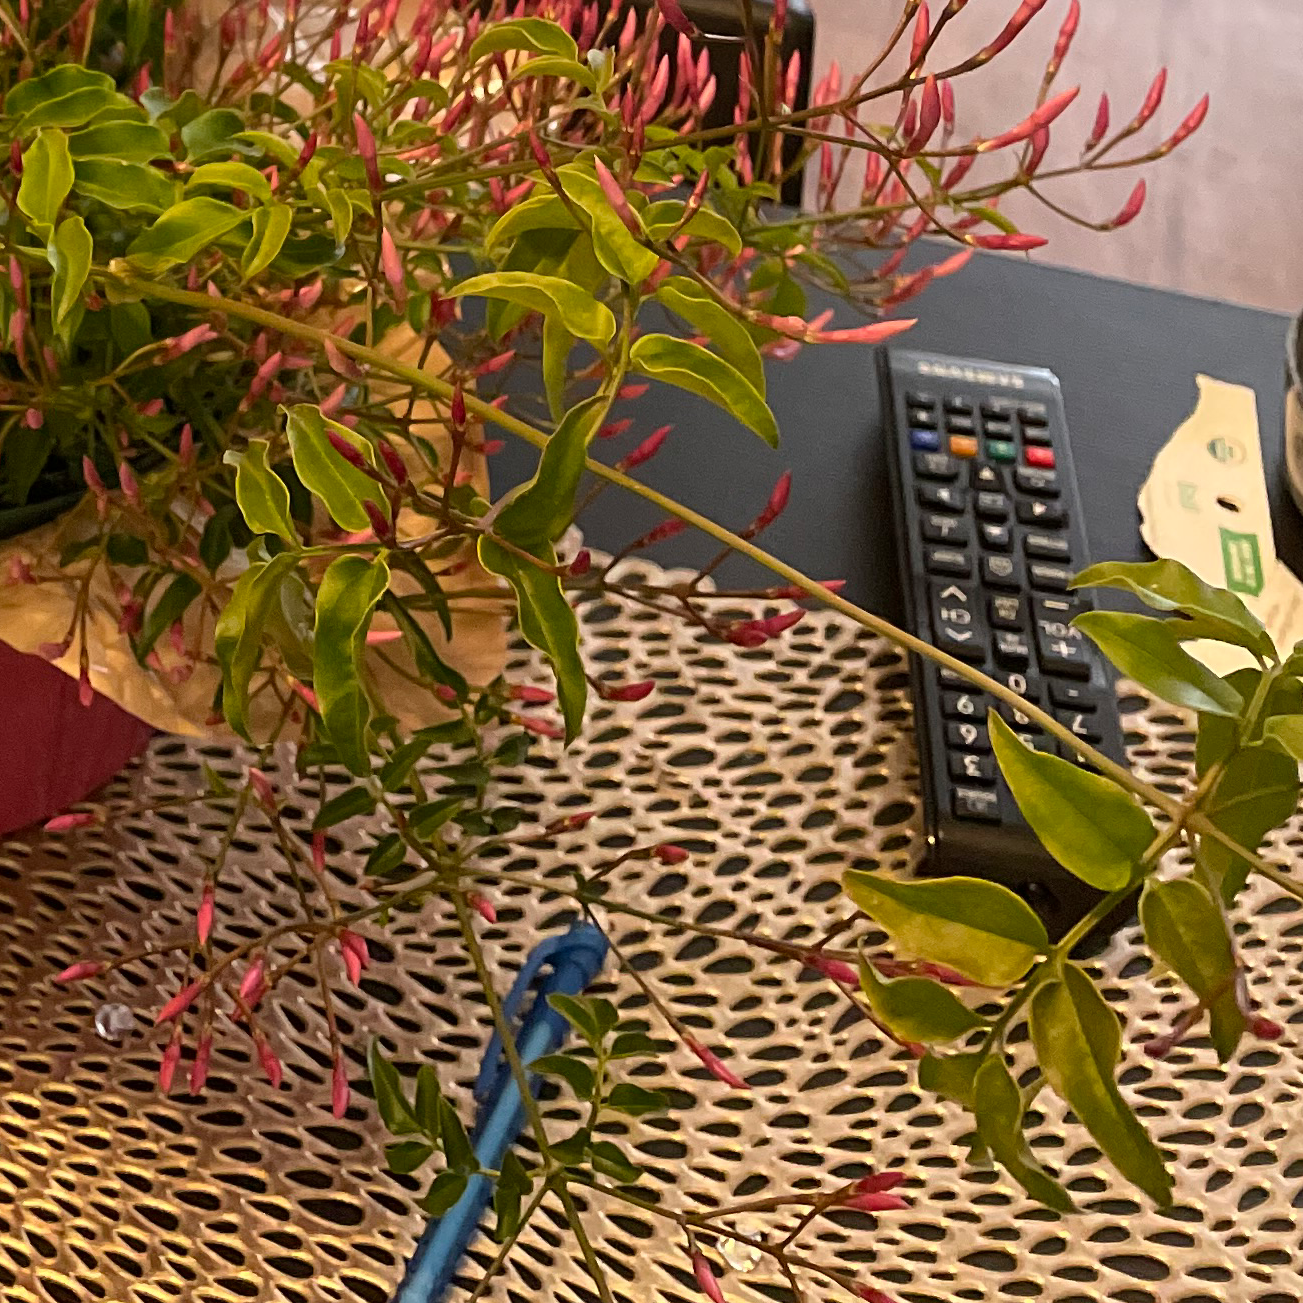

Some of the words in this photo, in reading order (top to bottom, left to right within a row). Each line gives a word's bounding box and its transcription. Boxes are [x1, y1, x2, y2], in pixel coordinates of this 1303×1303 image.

[1038, 619, 1083, 641] VOL
[956, 695, 975, 715] 9
[958, 723, 978, 745] 6
[1072, 714, 1088, 735] 7
[963, 755, 982, 777] 3
